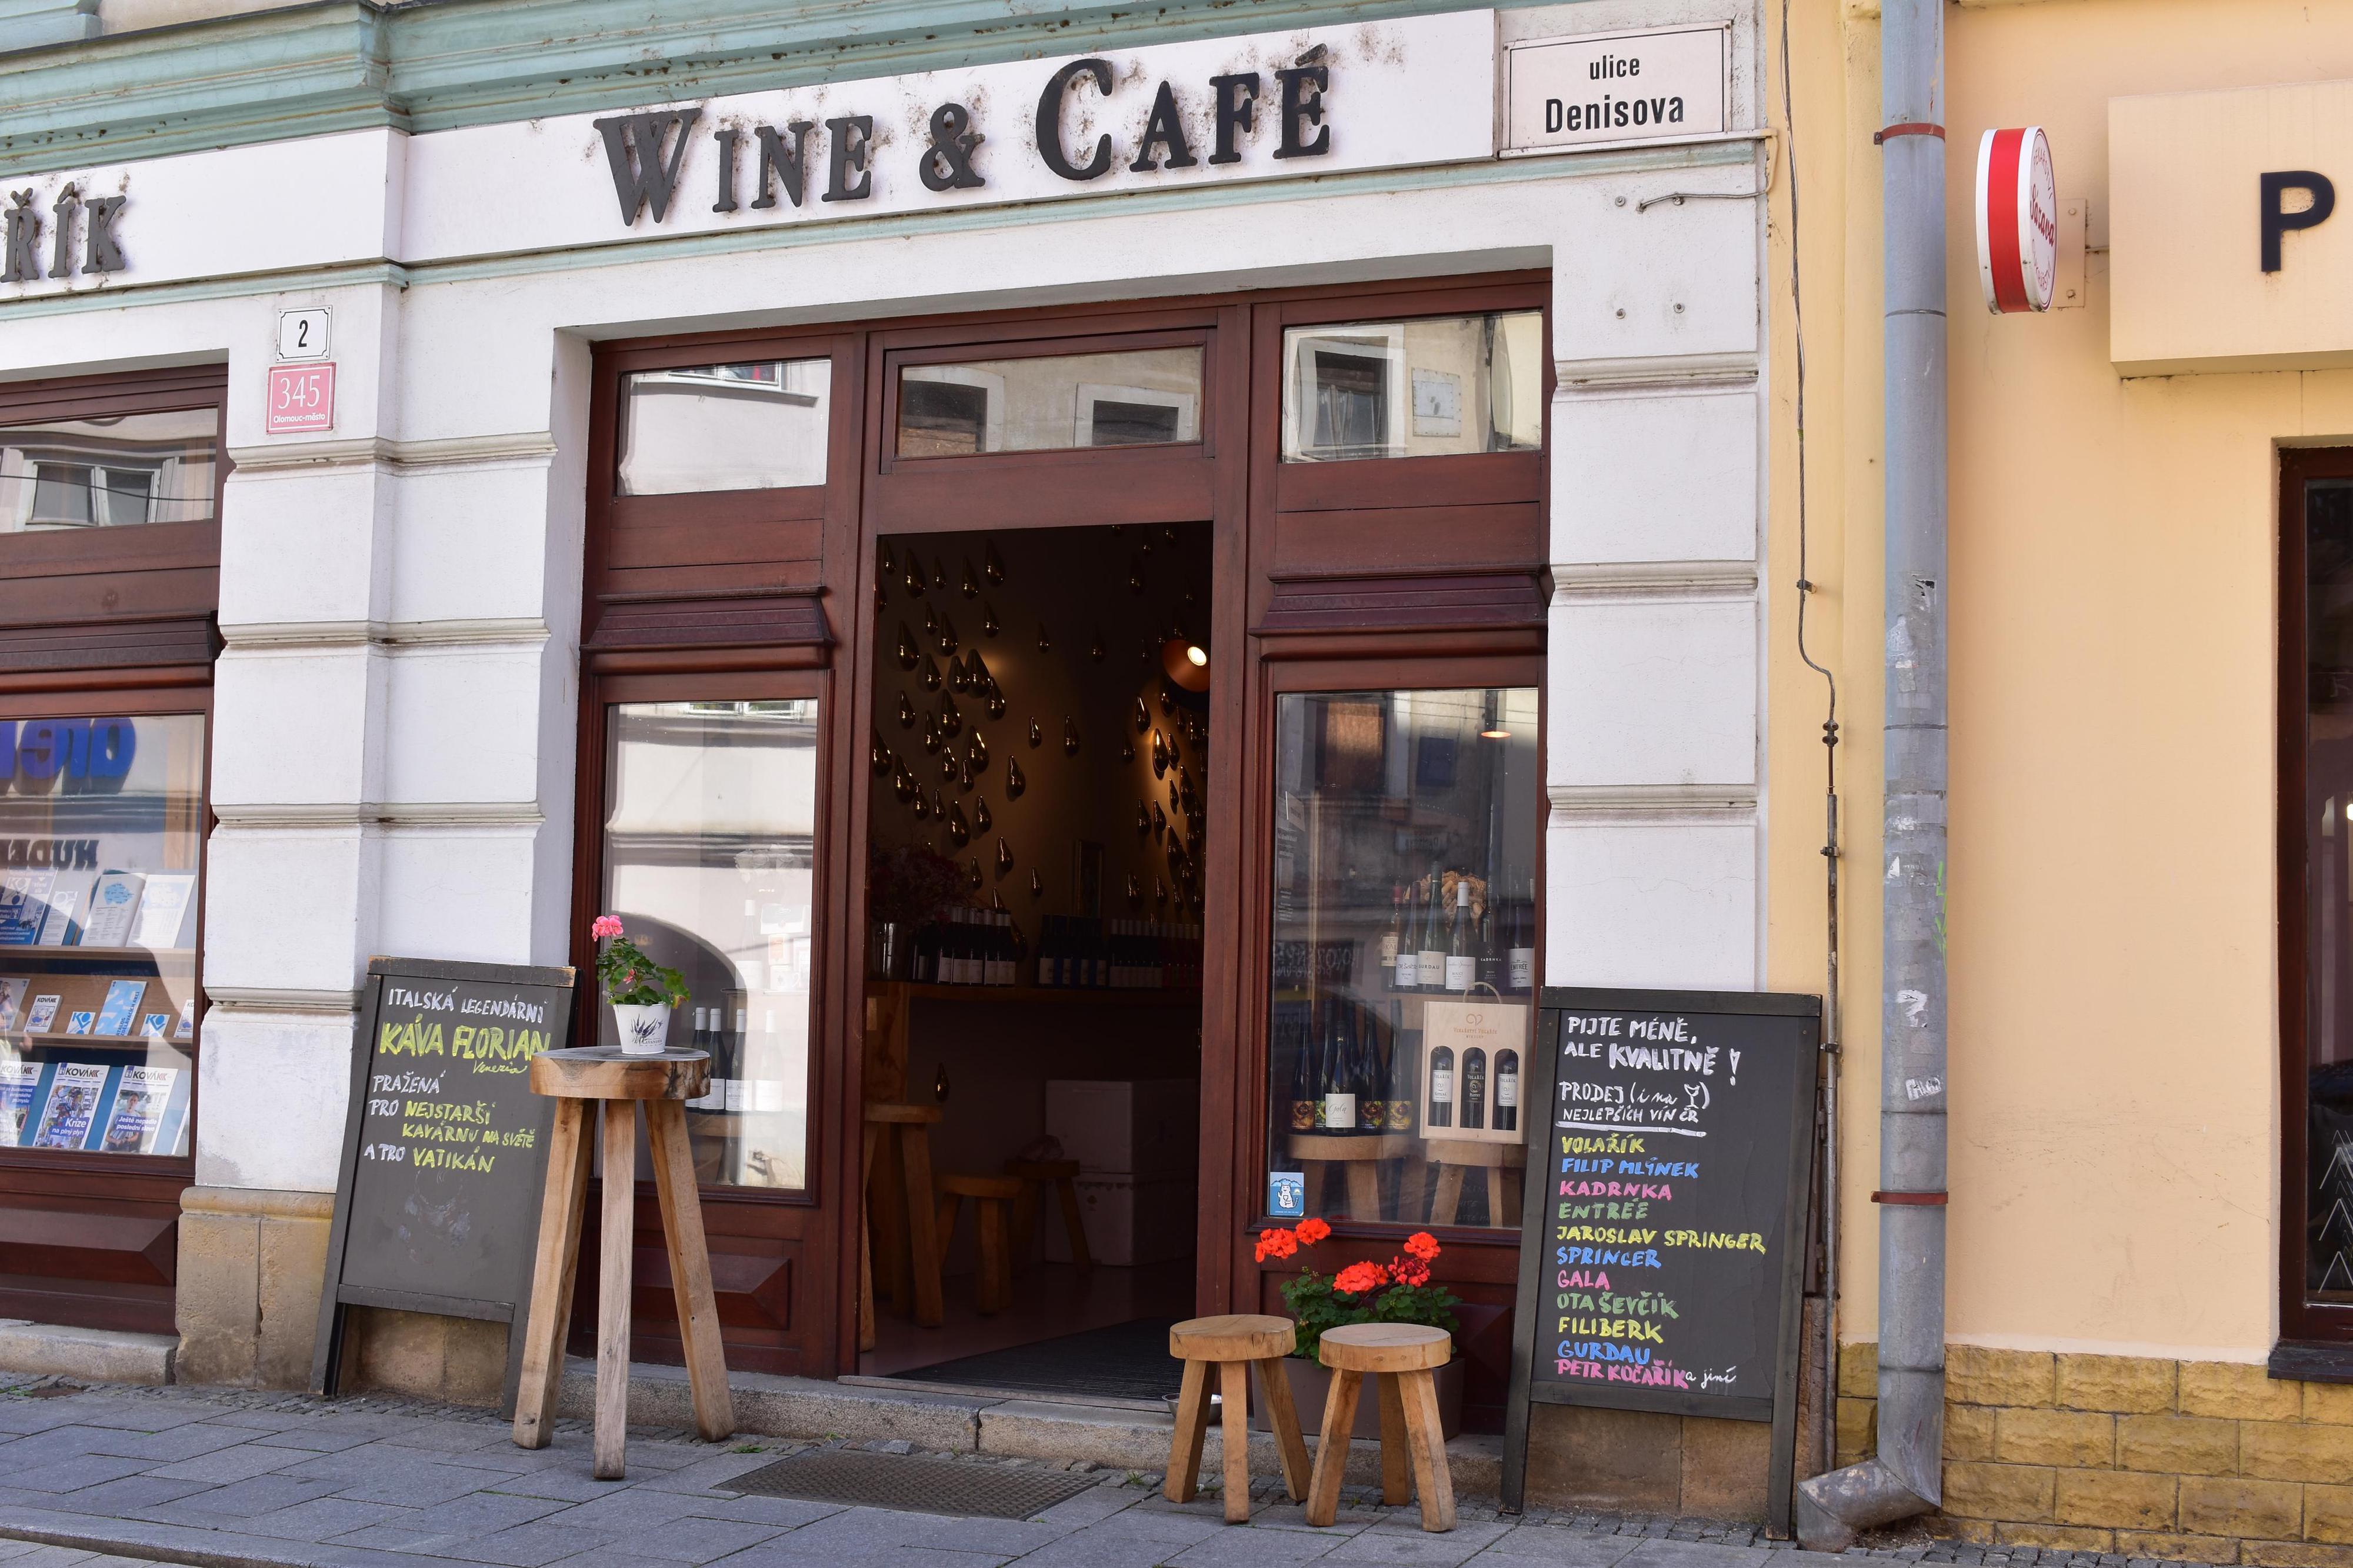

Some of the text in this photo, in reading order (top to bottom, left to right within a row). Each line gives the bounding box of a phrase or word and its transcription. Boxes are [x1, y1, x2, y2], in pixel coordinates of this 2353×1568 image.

[1588, 55, 1640, 81] ulice
[1544, 95, 1685, 134] Denisova
[594, 42, 1331, 226] WINE & CAFÉ
[2260, 170, 2335, 272] P
[298, 319, 309, 348] 2
[278, 375, 321, 409] 345
[273, 412, 325, 423] Olomouc-město
[388, 986, 549, 1024] ITALSKÁ LEGENDÁRNÍ
[379, 1013, 551, 1061] KÁVA FLORIAN
[1568, 1016, 1698, 1045] PIJTE MÉNĚ,
[1564, 1040, 1604, 1058] ALE
[1609, 1042, 1721, 1076] KVALITNĚ
[373, 1070, 446, 1094] PRAŽENÁ
[1559, 1080, 1624, 1102] PRODEJ
[65, 1117, 87, 1128] Krize
[369, 1099, 496, 1125] PRO NEJSTARŠÍ
[1563, 1104, 1699, 1123] NEJLEPŠÍCH VÍN ČR
[60, 1128, 73, 1136] plný
[402, 1120, 479, 1143] KAVÁRNU
[482, 1129, 499, 1145] NA
[1562, 1133, 1645, 1154] VOLAŘÍK
[364, 1143, 376, 1160] A
[412, 1146, 496, 1173] VATIKÁN
[1561, 1157, 1615, 1174] FILIP
[1559, 1180, 1673, 1201] KADRNKA
[1556, 1225, 1767, 1255] JAROSLAV SPRINGER
[1557, 1270, 1611, 1290] GALA
[1557, 1291, 1680, 1319] OTA ŠEVČÍK
[1558, 1316, 1664, 1344] FILIBERK
[1557, 1340, 1651, 1365] GURDAU
[1553, 1359, 1605, 1379] PETR
[1608, 1359, 1689, 1389] KOČAŘÍK
